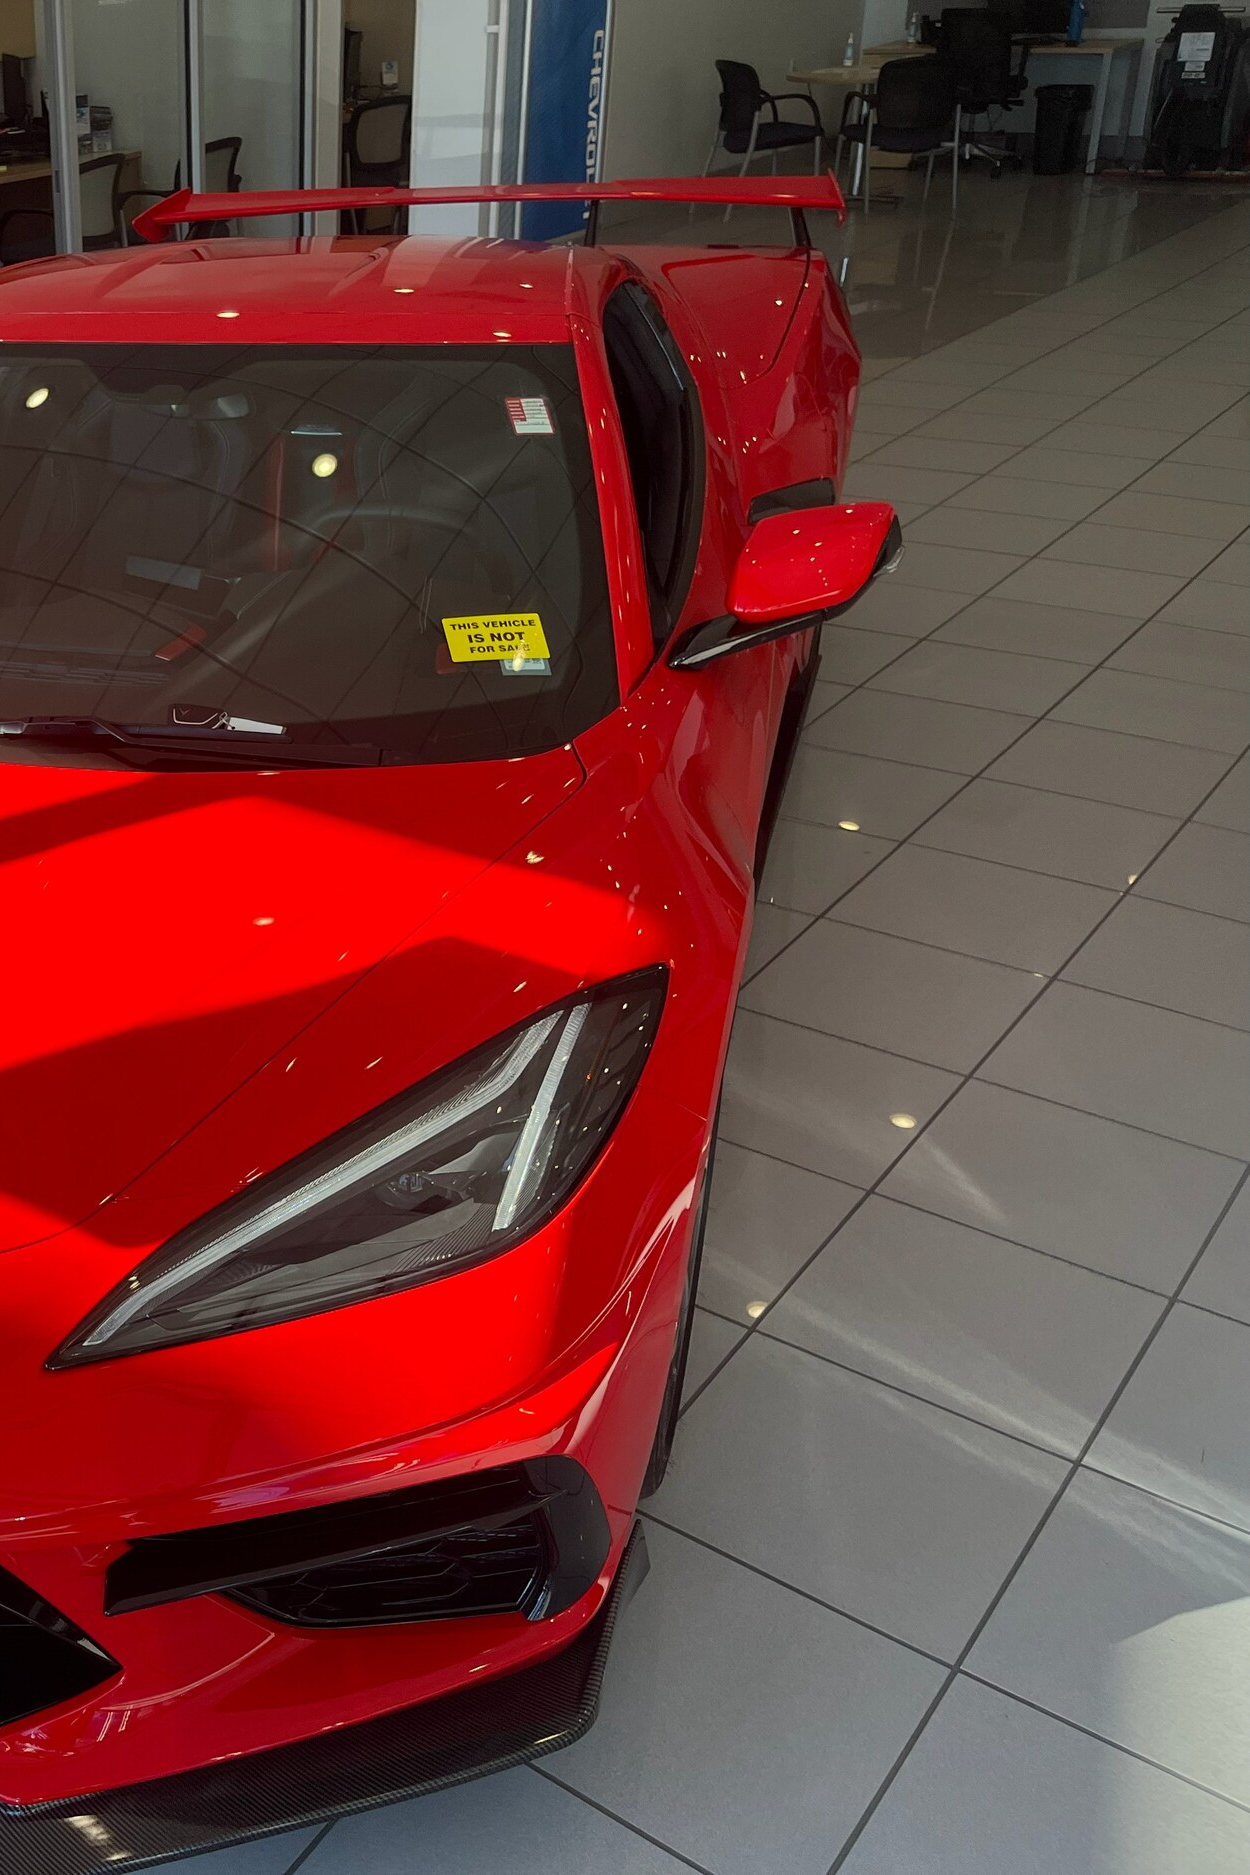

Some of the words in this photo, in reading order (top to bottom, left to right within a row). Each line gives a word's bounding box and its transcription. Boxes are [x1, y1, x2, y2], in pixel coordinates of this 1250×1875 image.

[582, 30, 604, 219] CHEVROL
[450, 622, 479, 630] THIS
[482, 619, 536, 628] VEHICLE
[467, 634, 485, 643] IS
[490, 632, 525, 642] NOT
[470, 646, 495, 654] FOR
